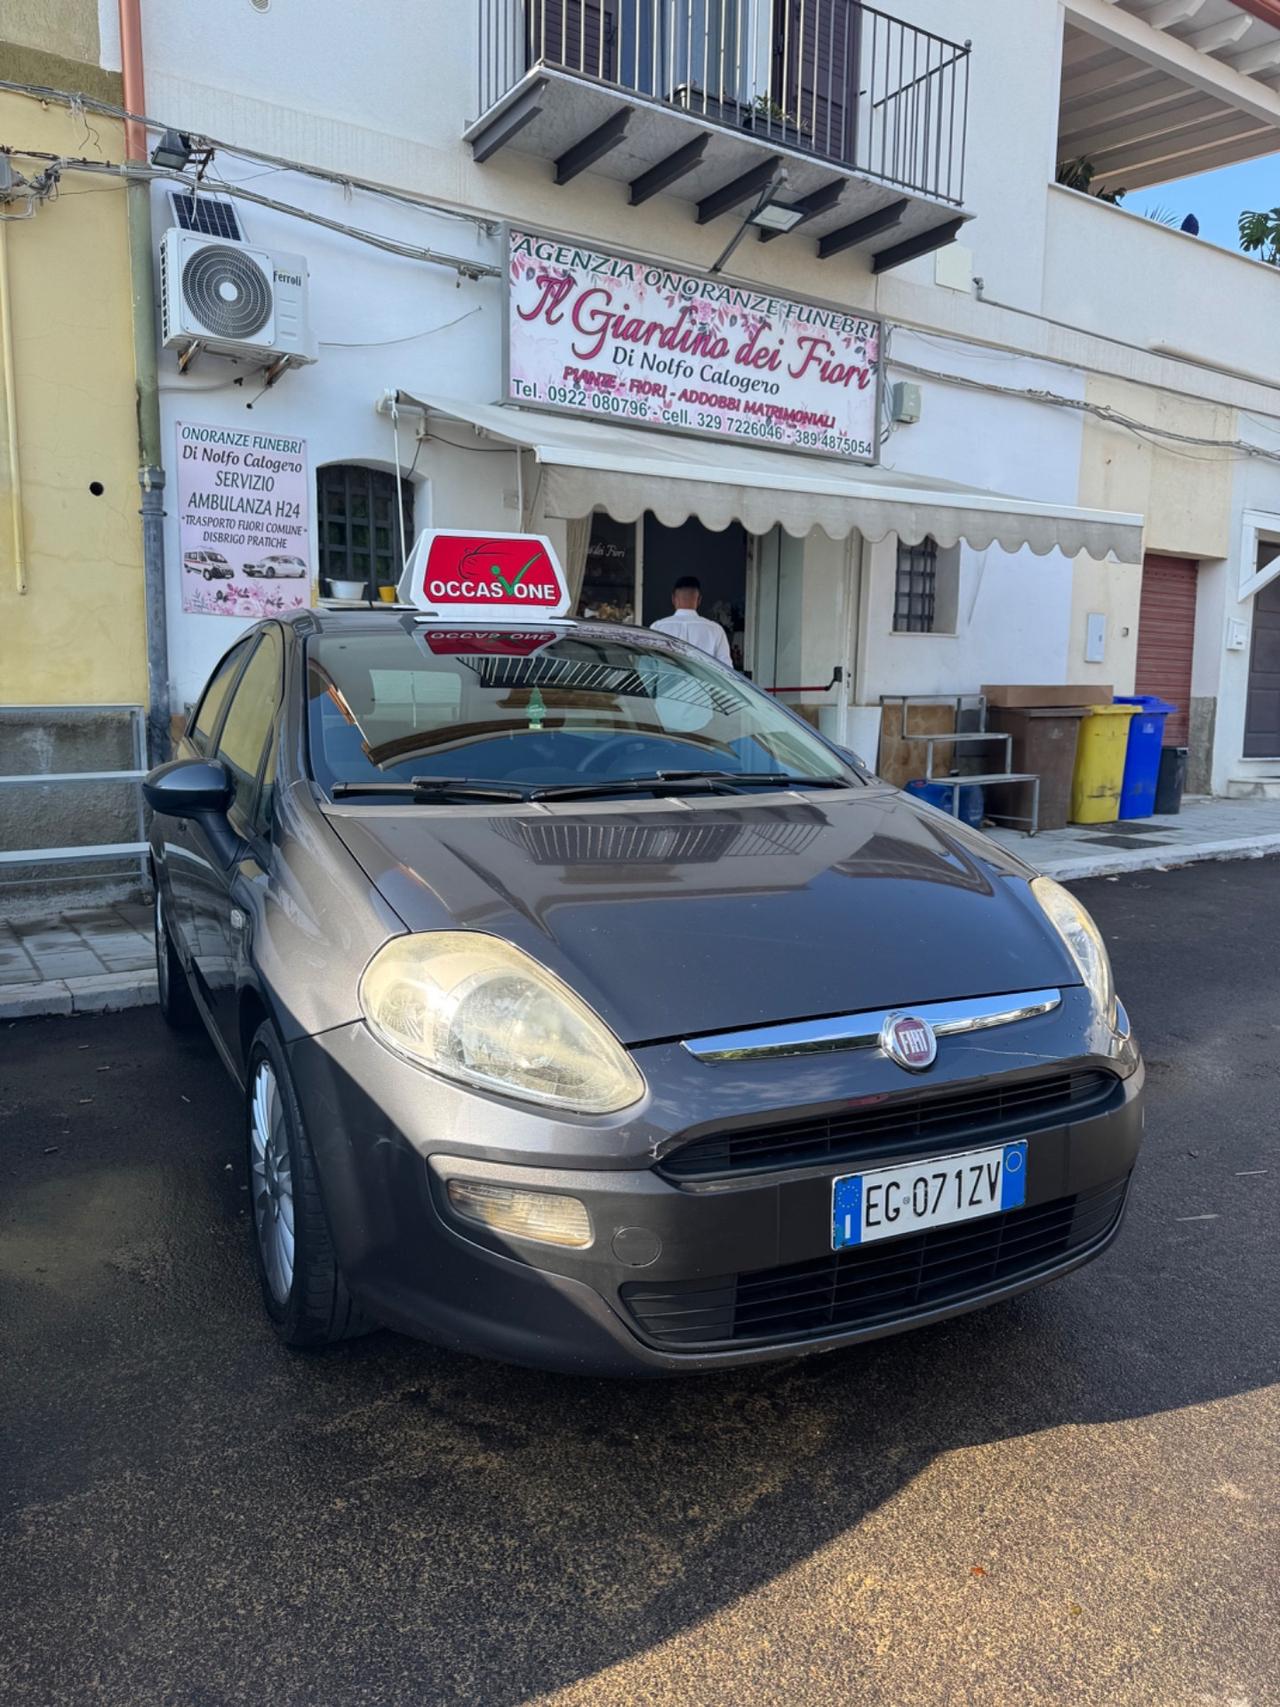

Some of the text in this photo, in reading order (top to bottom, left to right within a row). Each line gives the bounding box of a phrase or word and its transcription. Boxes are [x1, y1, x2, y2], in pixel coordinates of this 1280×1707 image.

[273, 270, 302, 287] Ferroli
[513, 238, 877, 339] AGENZIA ONORANZE FUNEBRI
[517, 275, 871, 391] Il Giardino dei Fiori
[612, 346, 781, 396] Di Nolfo Calogero
[562, 365, 618, 390] PIANTE
[629, 377, 668, 399] FIORI
[678, 388, 740, 412] ADDOBBI
[743, 400, 836, 430] MATRIMONIALI
[512, 379, 542, 399] Tel.
[547, 385, 587, 407] 0922
[592, 393, 648, 417] 080796
[662, 409, 693, 425] cell.
[697, 412, 722, 431] 329
[727, 417, 783, 441] 7226046
[795, 429, 818, 446] 389
[820, 433, 873, 456] 4875054
[182, 426, 303, 455] ONORANZE FUNEBRI
[182, 445, 303, 474] Di Nolfo Calogero
[215, 470, 275, 493] SERVIZIO
[188, 492, 301, 519] AMBULANZA H24
[203, 531, 288, 549] DISBRIGO PRATICHE
[238, 519, 264, 534] FUORI
[898, 1028, 928, 1056] FIAT
